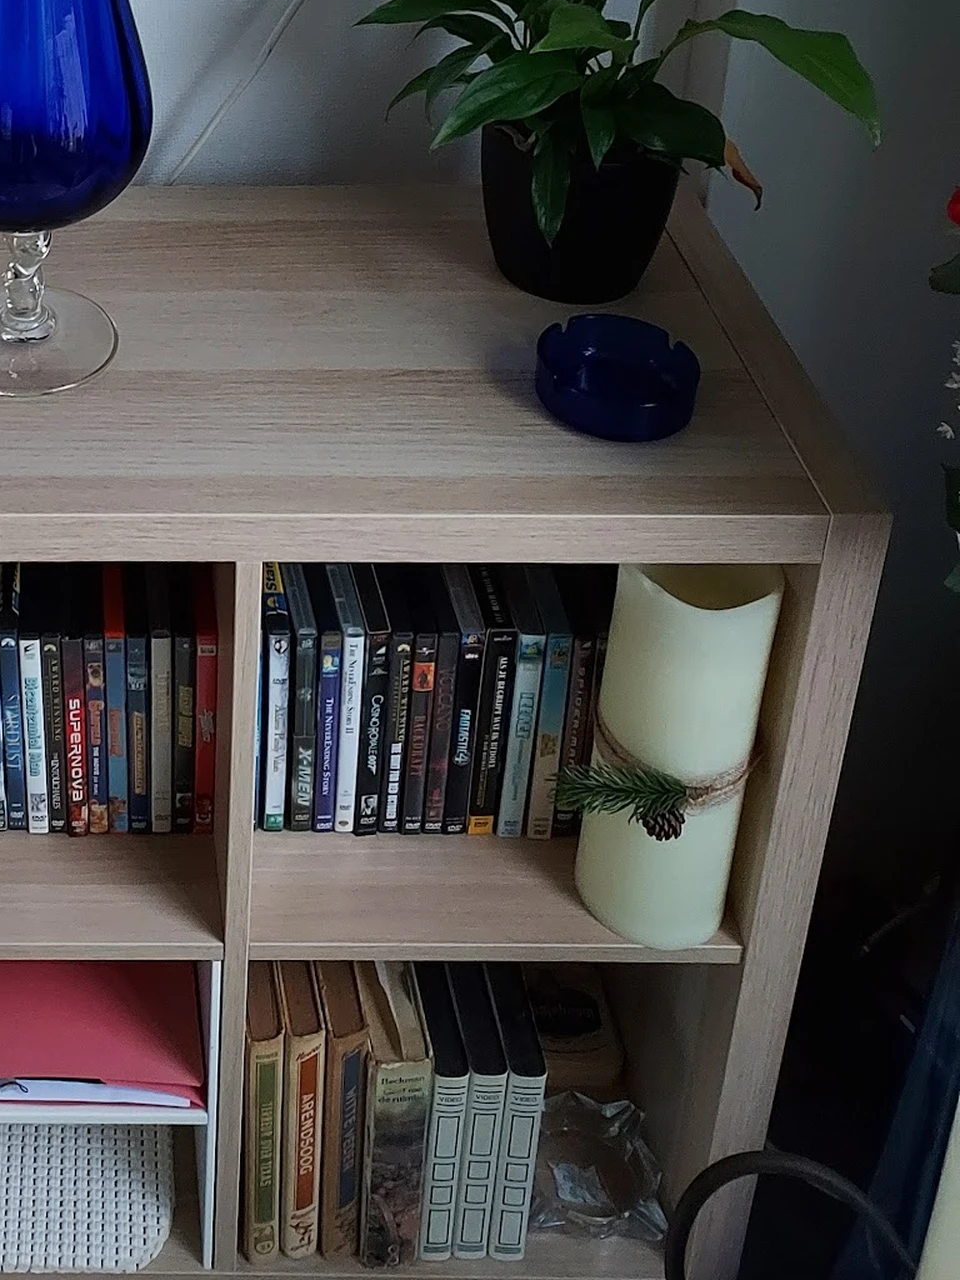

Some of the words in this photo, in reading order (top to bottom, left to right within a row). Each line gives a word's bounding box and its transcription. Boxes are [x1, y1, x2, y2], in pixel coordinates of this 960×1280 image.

[350, 644, 358, 656] THE
[499, 656, 509, 669] ALS
[51, 659, 60, 693] AWARD
[402, 659, 410, 693] AWARD
[498, 671, 507, 679] JE
[26, 677, 39, 749] Bicentennial
[326, 698, 334, 714] THE
[369, 695, 384, 727] CASINO
[437, 664, 455, 731] VOLCANO
[5, 695, 21, 770] STARDUST
[53, 698, 62, 741] WINNING
[398, 698, 407, 741] WINNING
[456, 709, 471, 753] FANTASTIC
[367, 727, 378, 755] ROYALE
[410, 716, 426, 777] BACKDRAFT
[29, 753, 41, 776] Man
[298, 747, 311, 806] X-MEN
[367, 755, 377, 775] 007
[321, 772, 331, 795] STORY
[343, 1086, 357, 1127] WITTE
[299, 1093, 314, 1174] ARENDSOOG
[342, 1128, 357, 1172] VEDER
